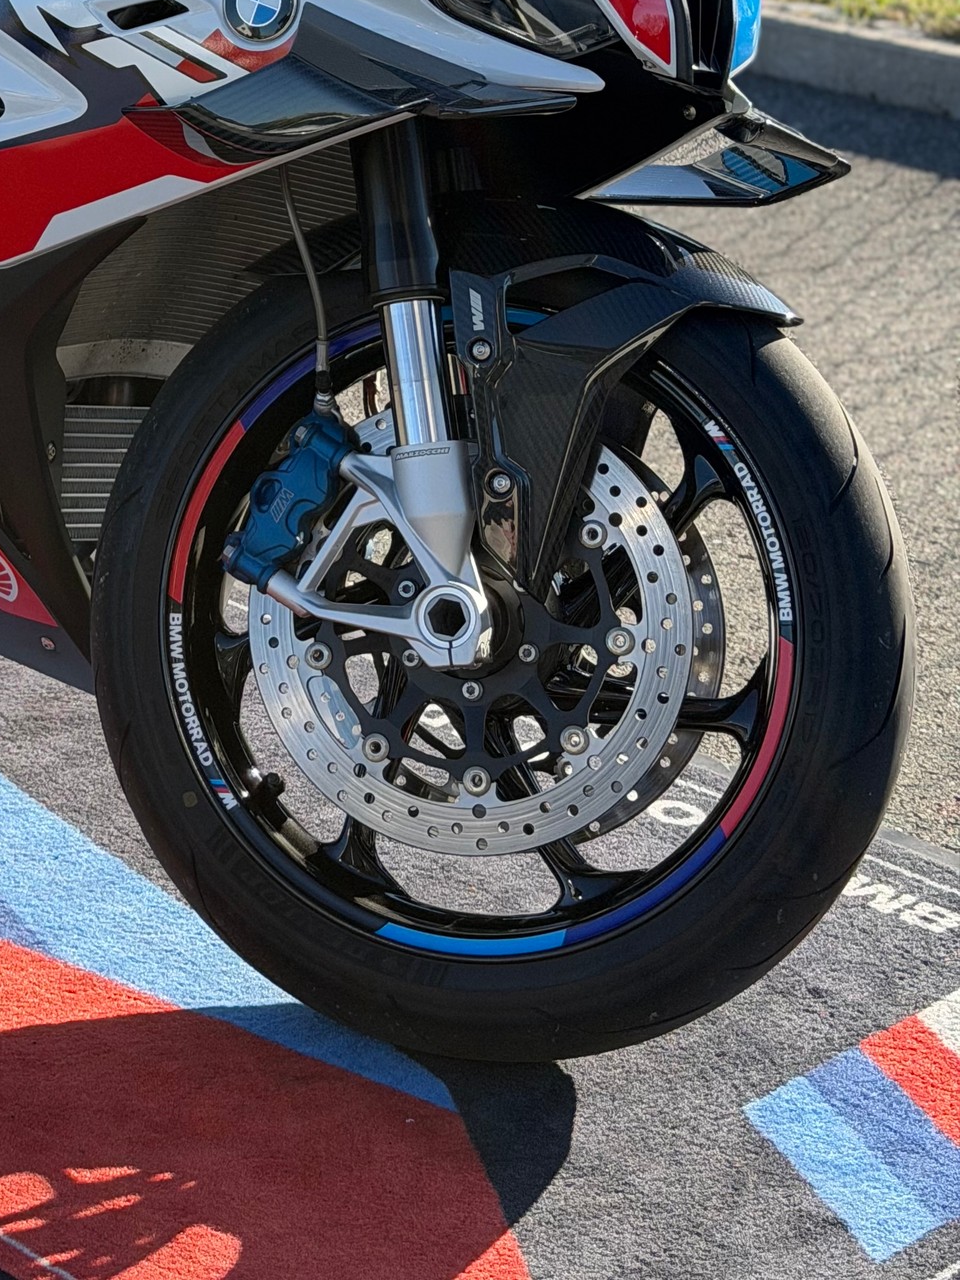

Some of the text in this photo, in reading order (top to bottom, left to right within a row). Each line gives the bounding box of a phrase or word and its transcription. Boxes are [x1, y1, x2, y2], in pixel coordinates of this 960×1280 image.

[395, 447, 451, 461] MARZOCCHI
[734, 461, 793, 621] BMW MOTORRAD
[168, 612, 214, 768] BMW MOTORRAD
